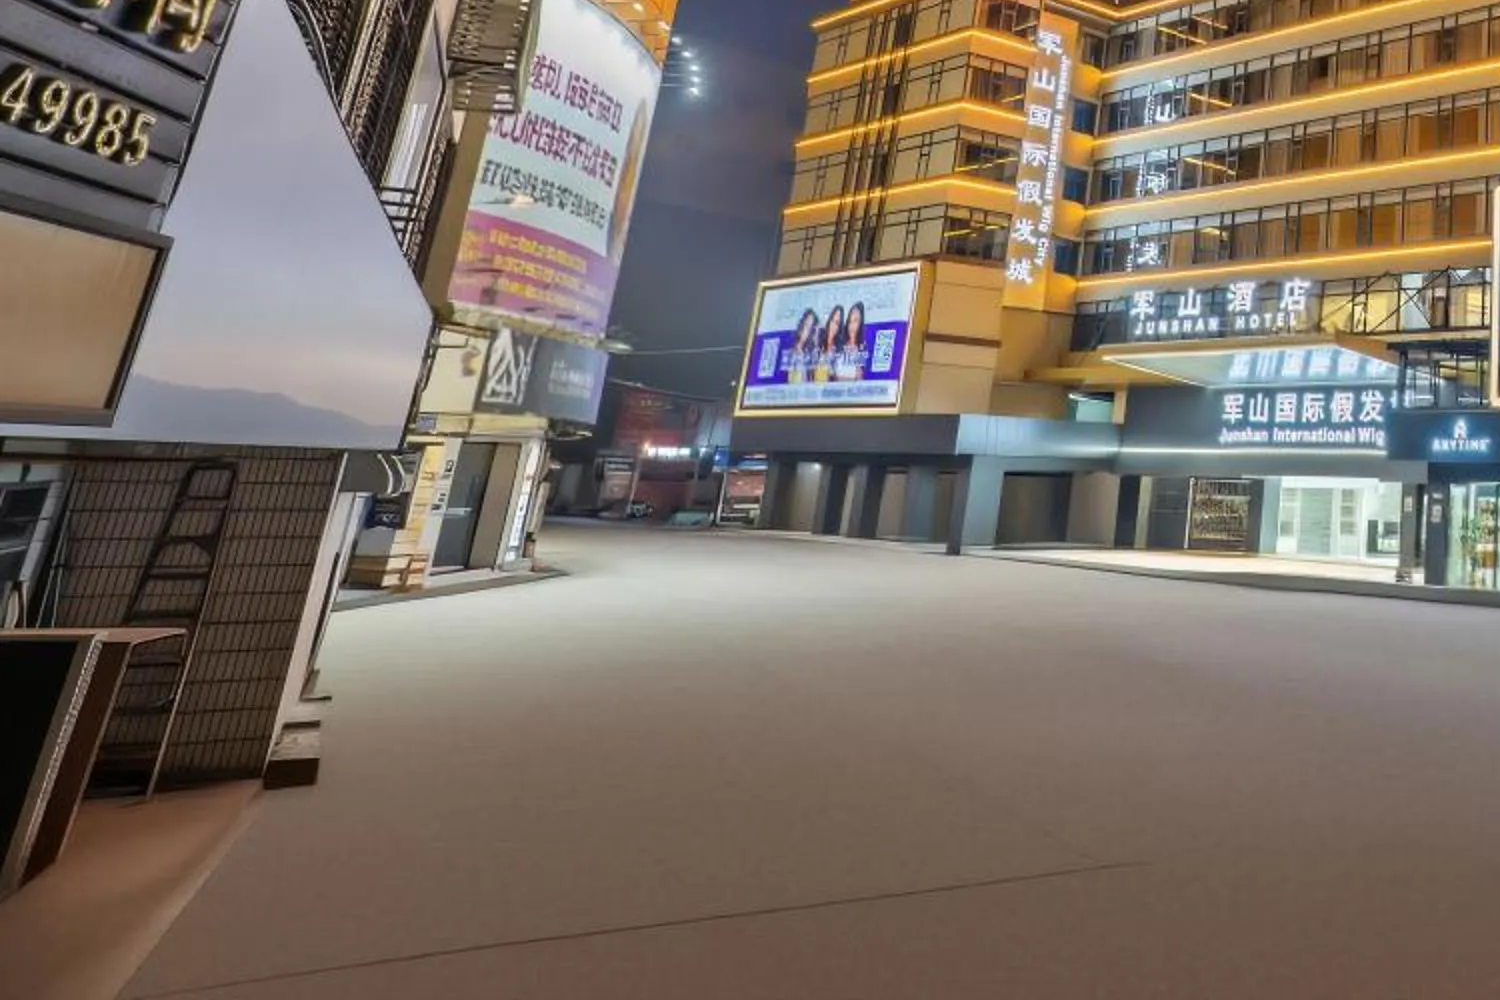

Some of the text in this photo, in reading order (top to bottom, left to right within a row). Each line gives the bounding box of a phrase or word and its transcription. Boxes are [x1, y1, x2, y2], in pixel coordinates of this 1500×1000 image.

[1, 67, 157, 166] 49985
[1129, 277, 1312, 320] 军山酒店
[1133, 311, 1297, 335] JUNSHAN HOTEL
[1222, 388, 1414, 425] 军山国际假发
[1219, 426, 1386, 446] Junshan International Wig
